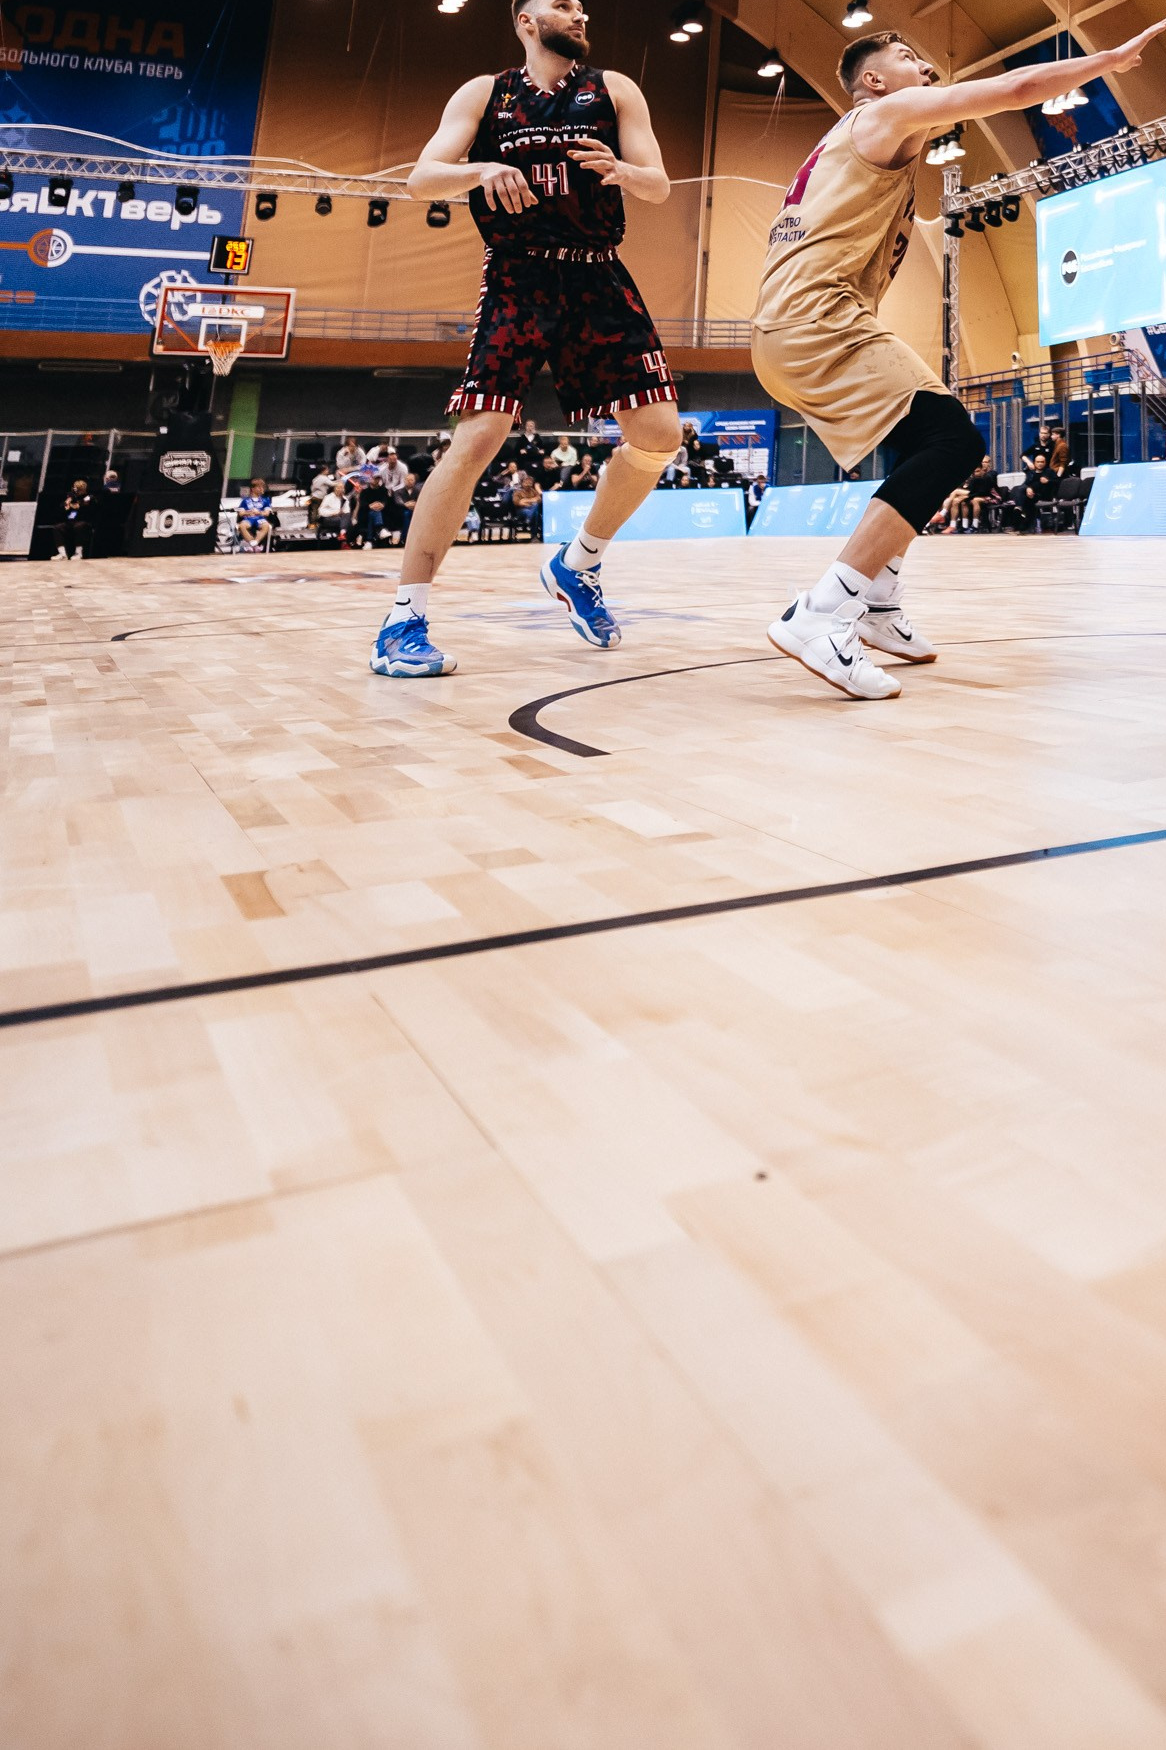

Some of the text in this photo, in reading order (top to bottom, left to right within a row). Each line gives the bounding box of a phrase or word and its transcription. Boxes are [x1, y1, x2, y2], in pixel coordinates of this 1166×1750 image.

[16, 5, 185, 59] ОДНА
[0, 47, 183, 80] БОЛЬНОГО КЛУБА ТВЕРЬ
[531, 161, 570, 197] 41
[226, 251, 248, 270] 13
[143, 509, 180, 538] 10
